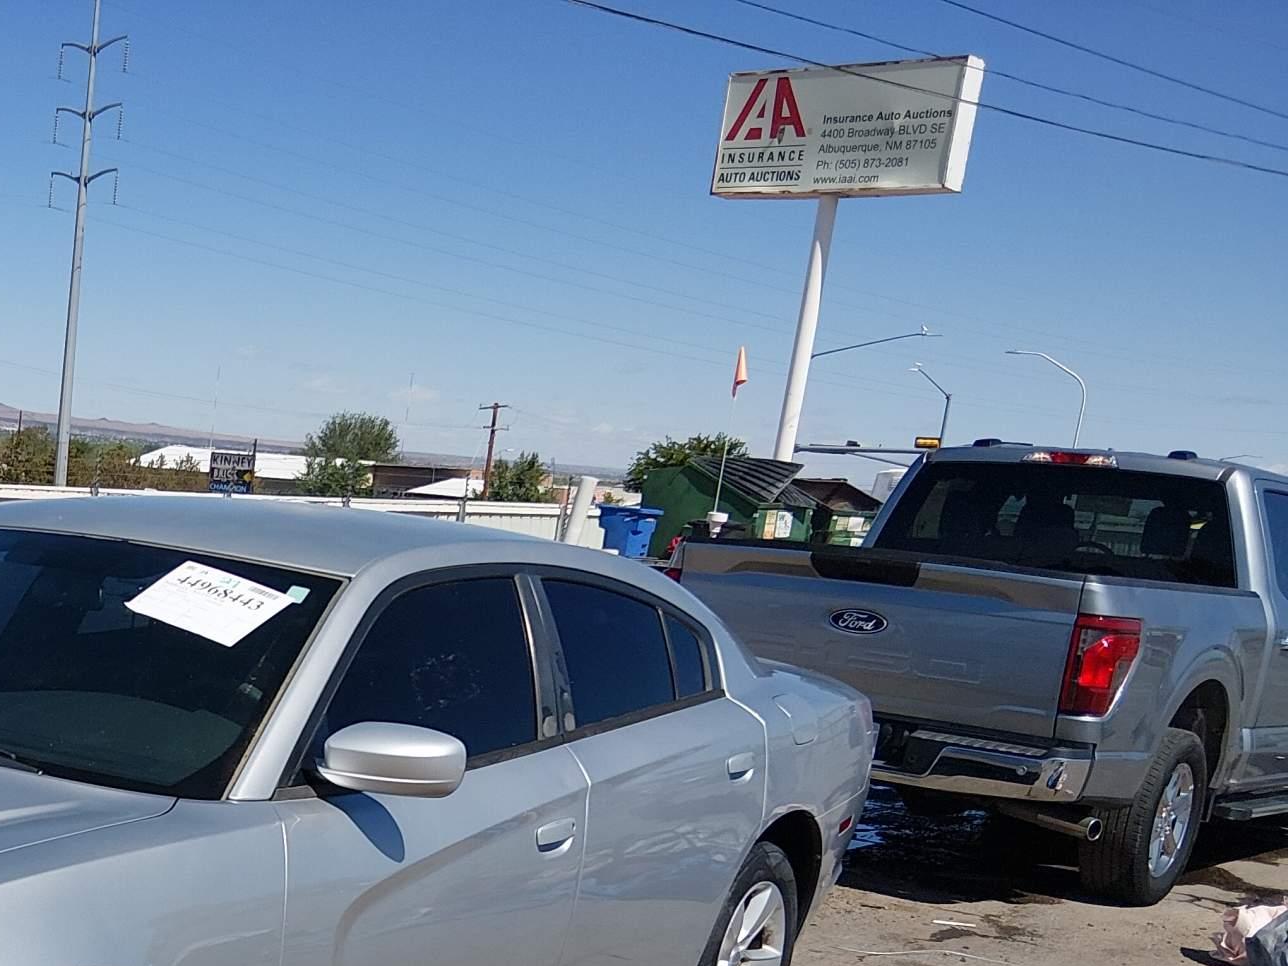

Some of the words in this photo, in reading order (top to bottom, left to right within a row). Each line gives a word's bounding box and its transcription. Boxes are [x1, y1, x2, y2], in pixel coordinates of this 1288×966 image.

[822, 114, 874, 125] Insurance
[876, 111, 901, 121] Auto
[903, 108, 953, 120] Auctions
[820, 128, 845, 139] 4400
[847, 126, 895, 138] Broadway
[898, 123, 928, 135] BLVD
[929, 122, 946, 134] SE
[818, 143, 882, 157] Albuquerque,
[884, 140, 903, 151] NM
[905, 138, 938, 150] 87105
[721, 150, 805, 164] INSURANCE
[815, 159, 832, 170] Ph:
[834, 159, 861, 171] (505)
[862, 157, 909, 169] 873-2081
[717, 171, 746, 184] AUTO
[748, 170, 802, 183] AUCTIONS
[812, 174, 880, 185] www.iaai.com
[212, 455, 253, 468] KINNEY
[177, 575, 265, 611] 44968443
[838, 611, 877, 631] Ford
